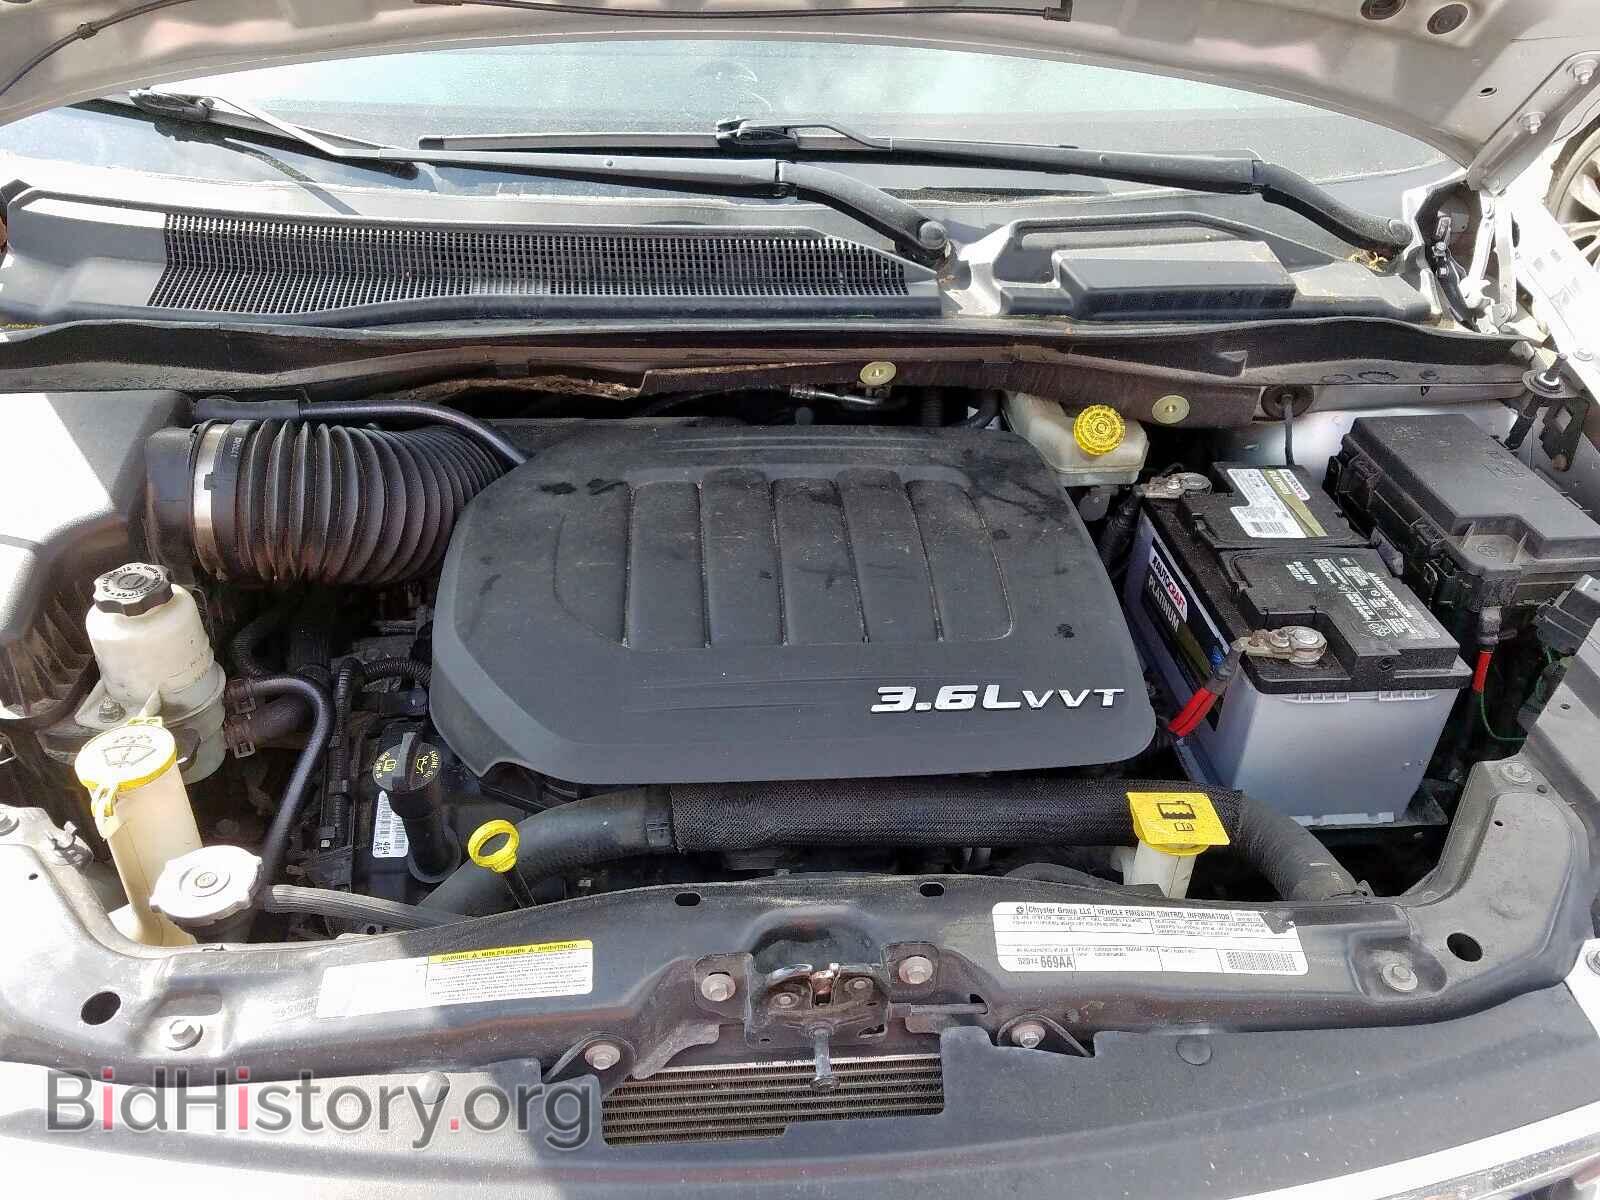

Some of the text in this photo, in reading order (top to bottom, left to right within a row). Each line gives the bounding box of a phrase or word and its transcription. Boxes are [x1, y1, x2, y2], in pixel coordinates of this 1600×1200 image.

[1148, 574, 1180, 633] PLATINUM
[871, 684, 1125, 712] 3.6L VVT
[1028, 905, 1056, 914] Chrysler
[1057, 907, 1077, 915] Group
[1097, 908, 1124, 916] VEHICLE
[1125, 909, 1155, 918] EMISSION
[1156, 911, 1185, 919] CONTROL
[1187, 911, 1230, 920] INFORMATION
[440, 953, 469, 961] WARNING
[1040, 955, 1074, 969] 669AA
